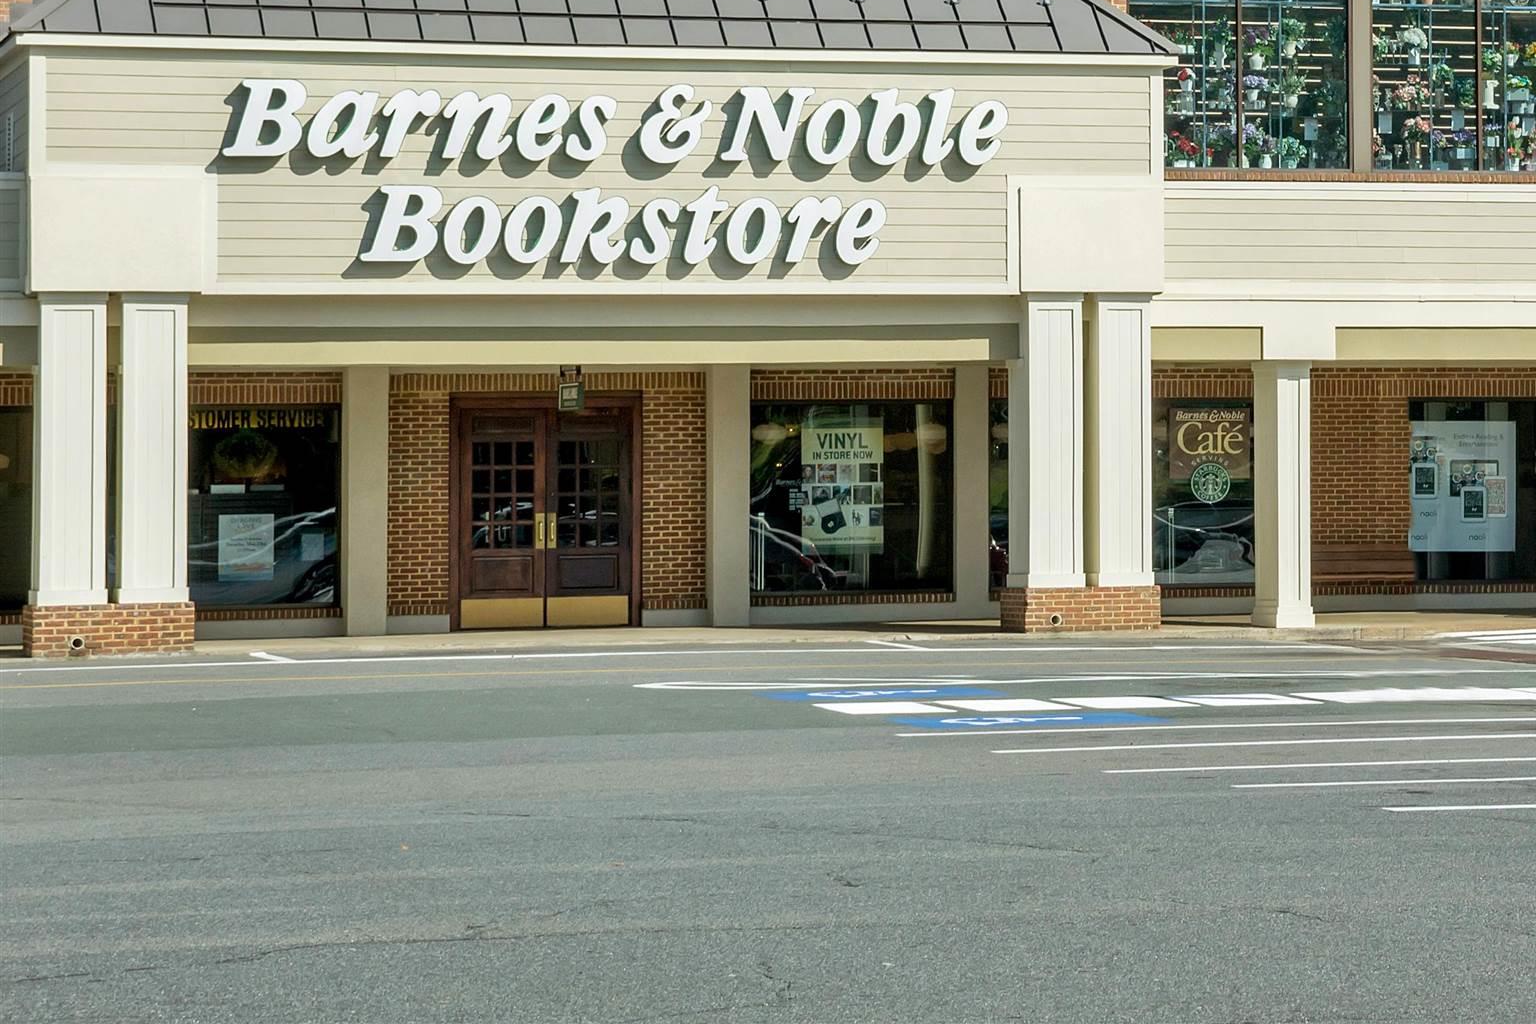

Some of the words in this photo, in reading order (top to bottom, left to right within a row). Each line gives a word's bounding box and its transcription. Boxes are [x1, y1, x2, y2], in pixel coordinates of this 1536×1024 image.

[221, 77, 618, 164] Barnes
[638, 83, 714, 165] &
[720, 86, 1010, 166] Noble
[359, 184, 889, 266] Bookstore
[1175, 410, 1209, 420] Barnes
[1209, 409, 1219, 423] &
[1219, 410, 1246, 420] Noble
[816, 432, 869, 450] VINYL
[1176, 421, 1244, 455] Café
[812, 451, 822, 460] IN
[823, 450, 851, 461] STORE
[853, 450, 874, 460] NOW
